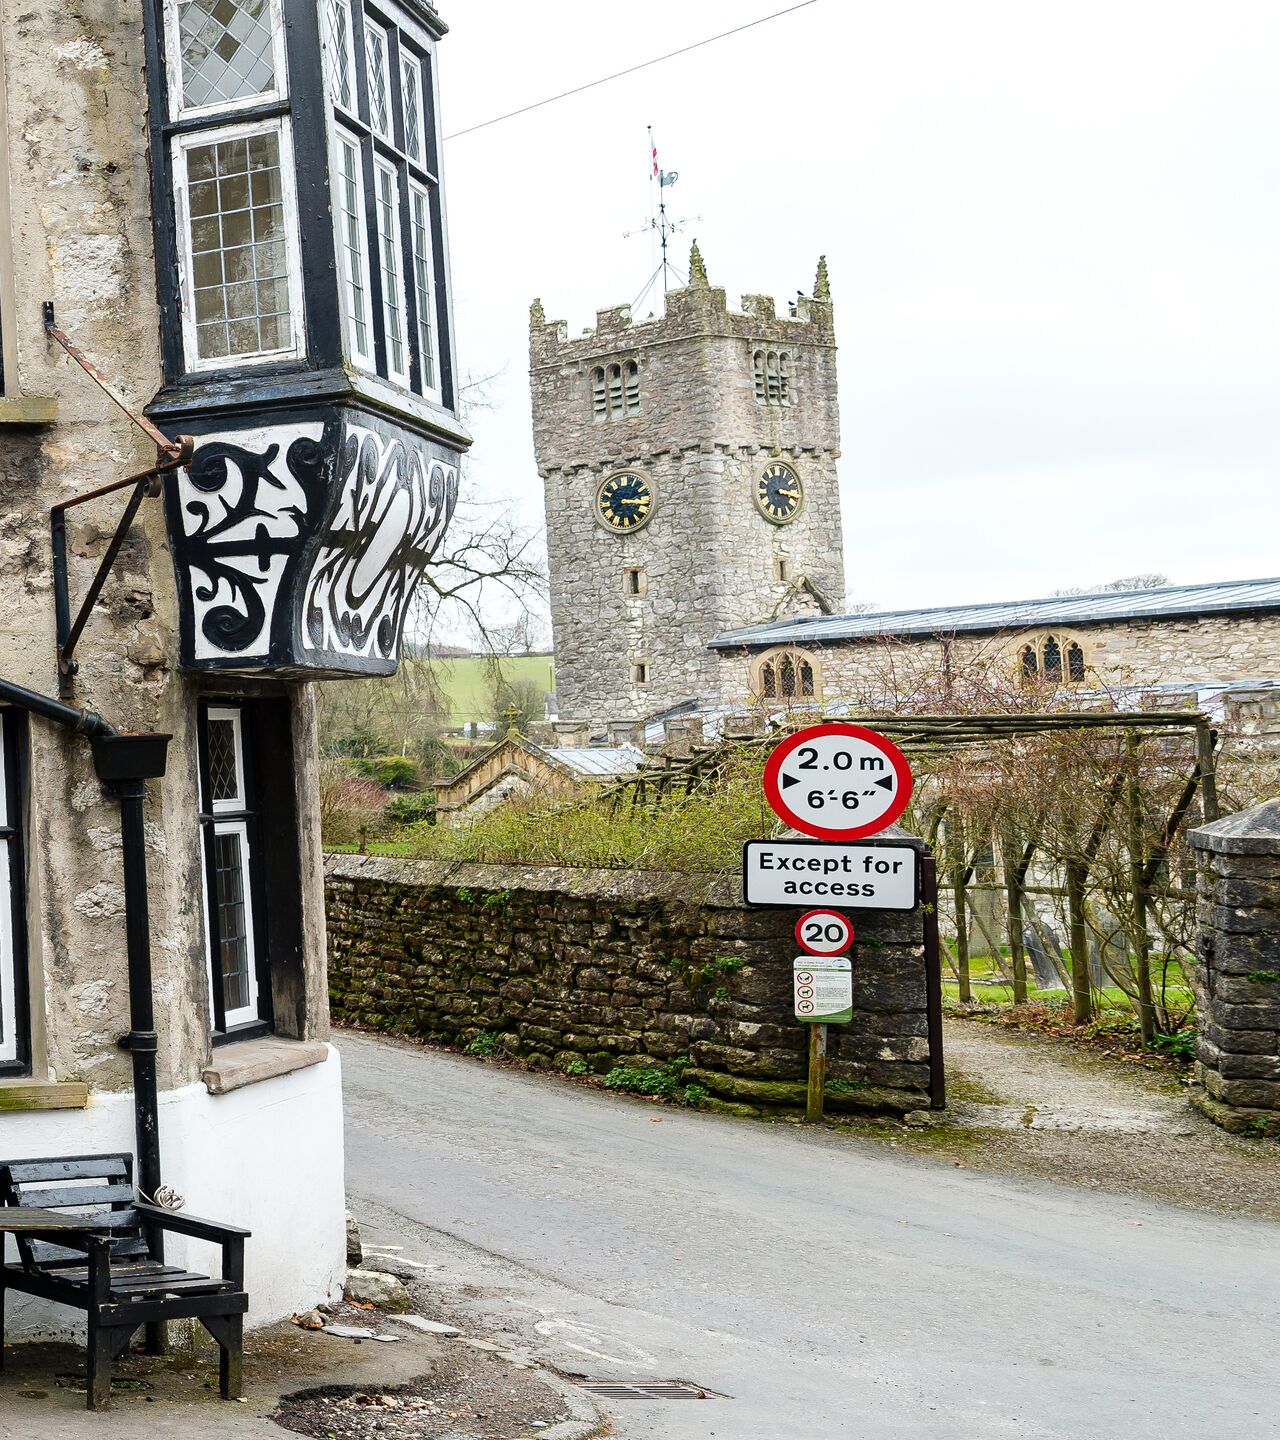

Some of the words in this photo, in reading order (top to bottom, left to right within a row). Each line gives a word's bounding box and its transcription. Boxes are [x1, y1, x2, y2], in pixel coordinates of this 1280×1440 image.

[759, 852, 852, 875] Except
[862, 855, 903, 874] for
[783, 880, 876, 897] access
[805, 923, 844, 943] 20
